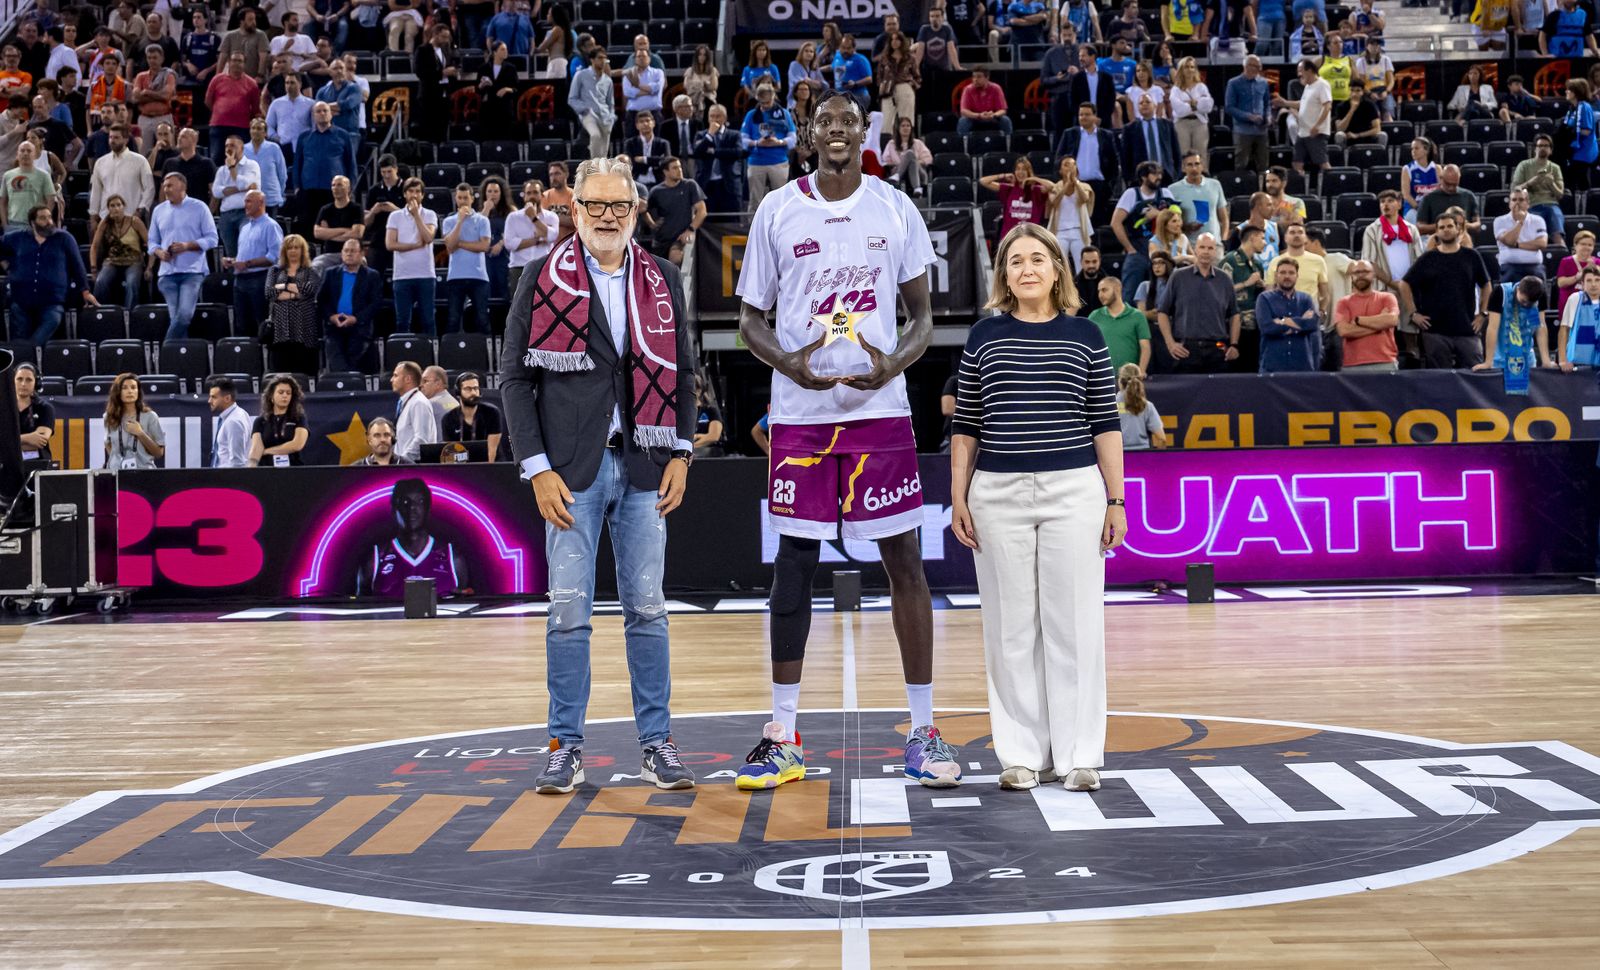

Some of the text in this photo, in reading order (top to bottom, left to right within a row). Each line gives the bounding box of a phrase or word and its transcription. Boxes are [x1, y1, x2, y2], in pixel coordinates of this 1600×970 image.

[768, 0, 898, 20] O NADA
[832, 326, 849, 335] MVP
[772, 478, 796, 505] 23
[1103, 469, 1498, 559] UATH
[413, 746, 550, 759] Liga
[40, 755, 1600, 868] FINAL FOUR
[873, 852, 933, 860] FEB
